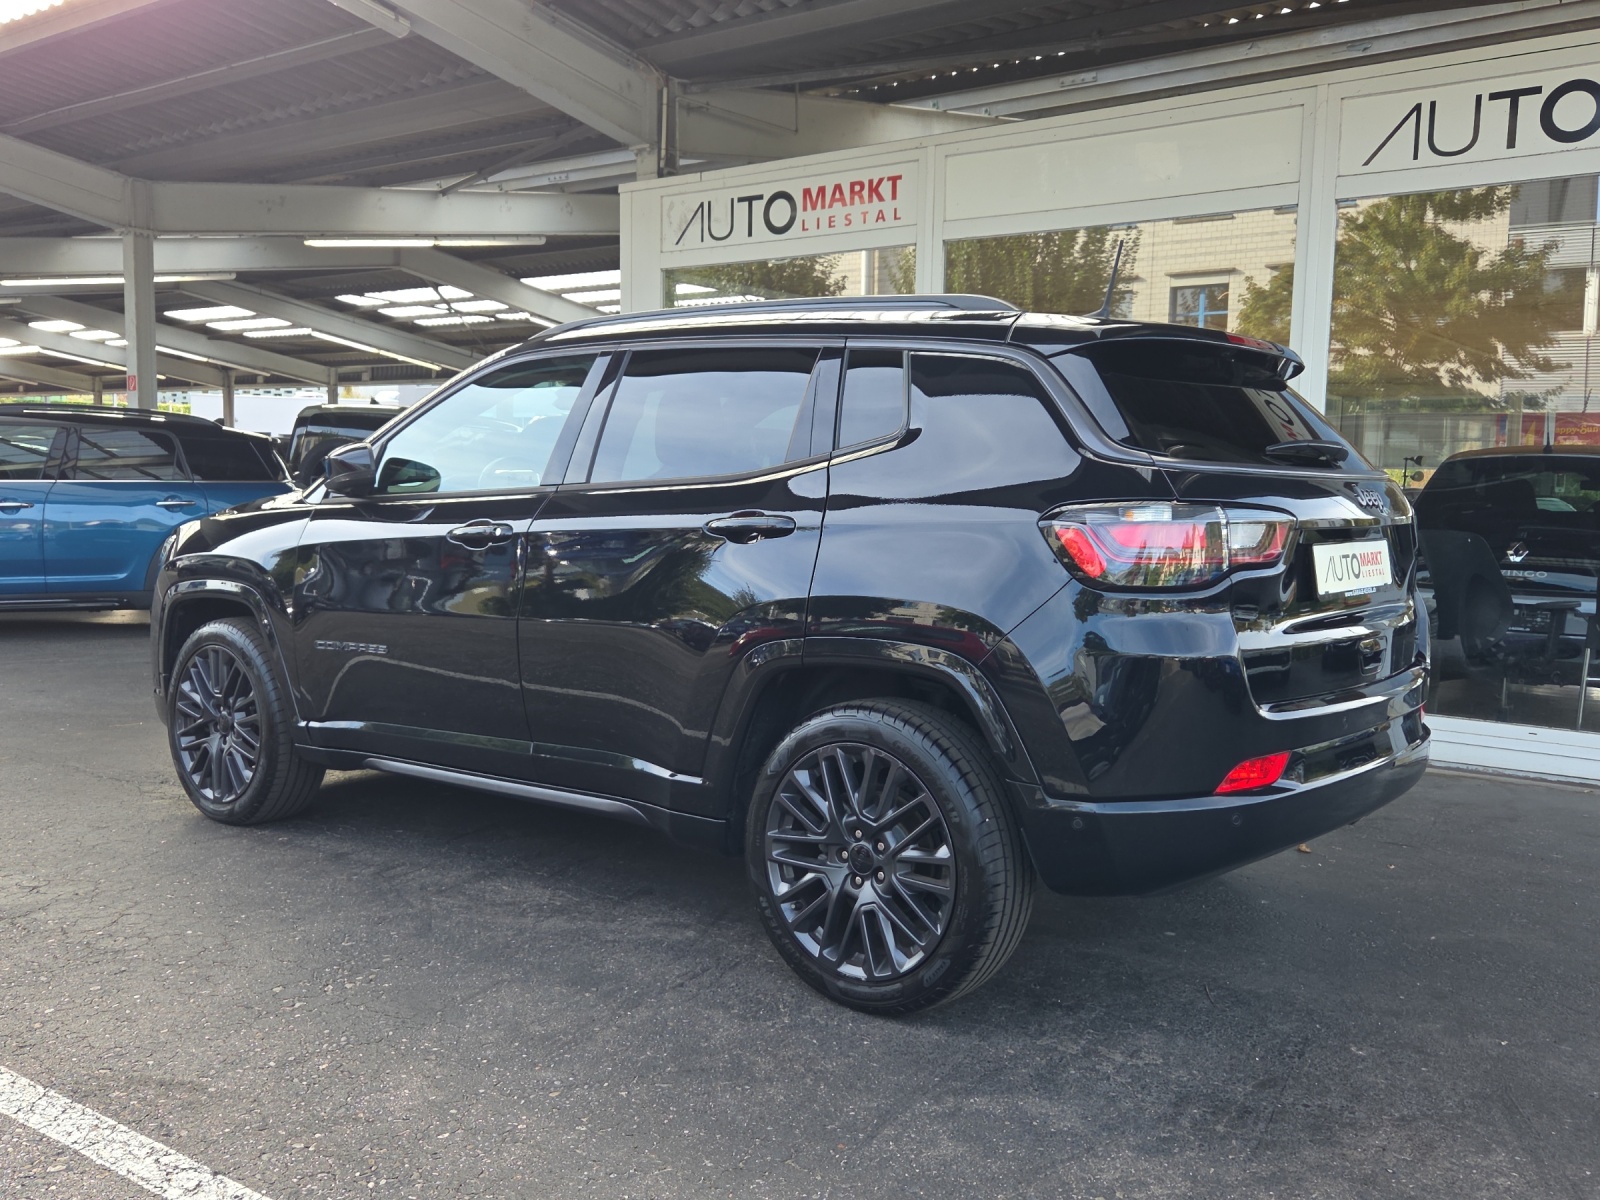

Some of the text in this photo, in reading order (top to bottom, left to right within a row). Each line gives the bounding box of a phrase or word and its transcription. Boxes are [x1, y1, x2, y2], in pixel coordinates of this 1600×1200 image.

[1361, 78, 1600, 167] AUTO
[675, 174, 903, 245] AUTO MARKT
[802, 207, 902, 232] LIESTAL
[1353, 485, 1384, 510] Jeep
[1325, 551, 1383, 583] AUTO MARKT
[1361, 568, 1385, 578] LIESTAL
[314, 640, 388, 654] COMPASS
